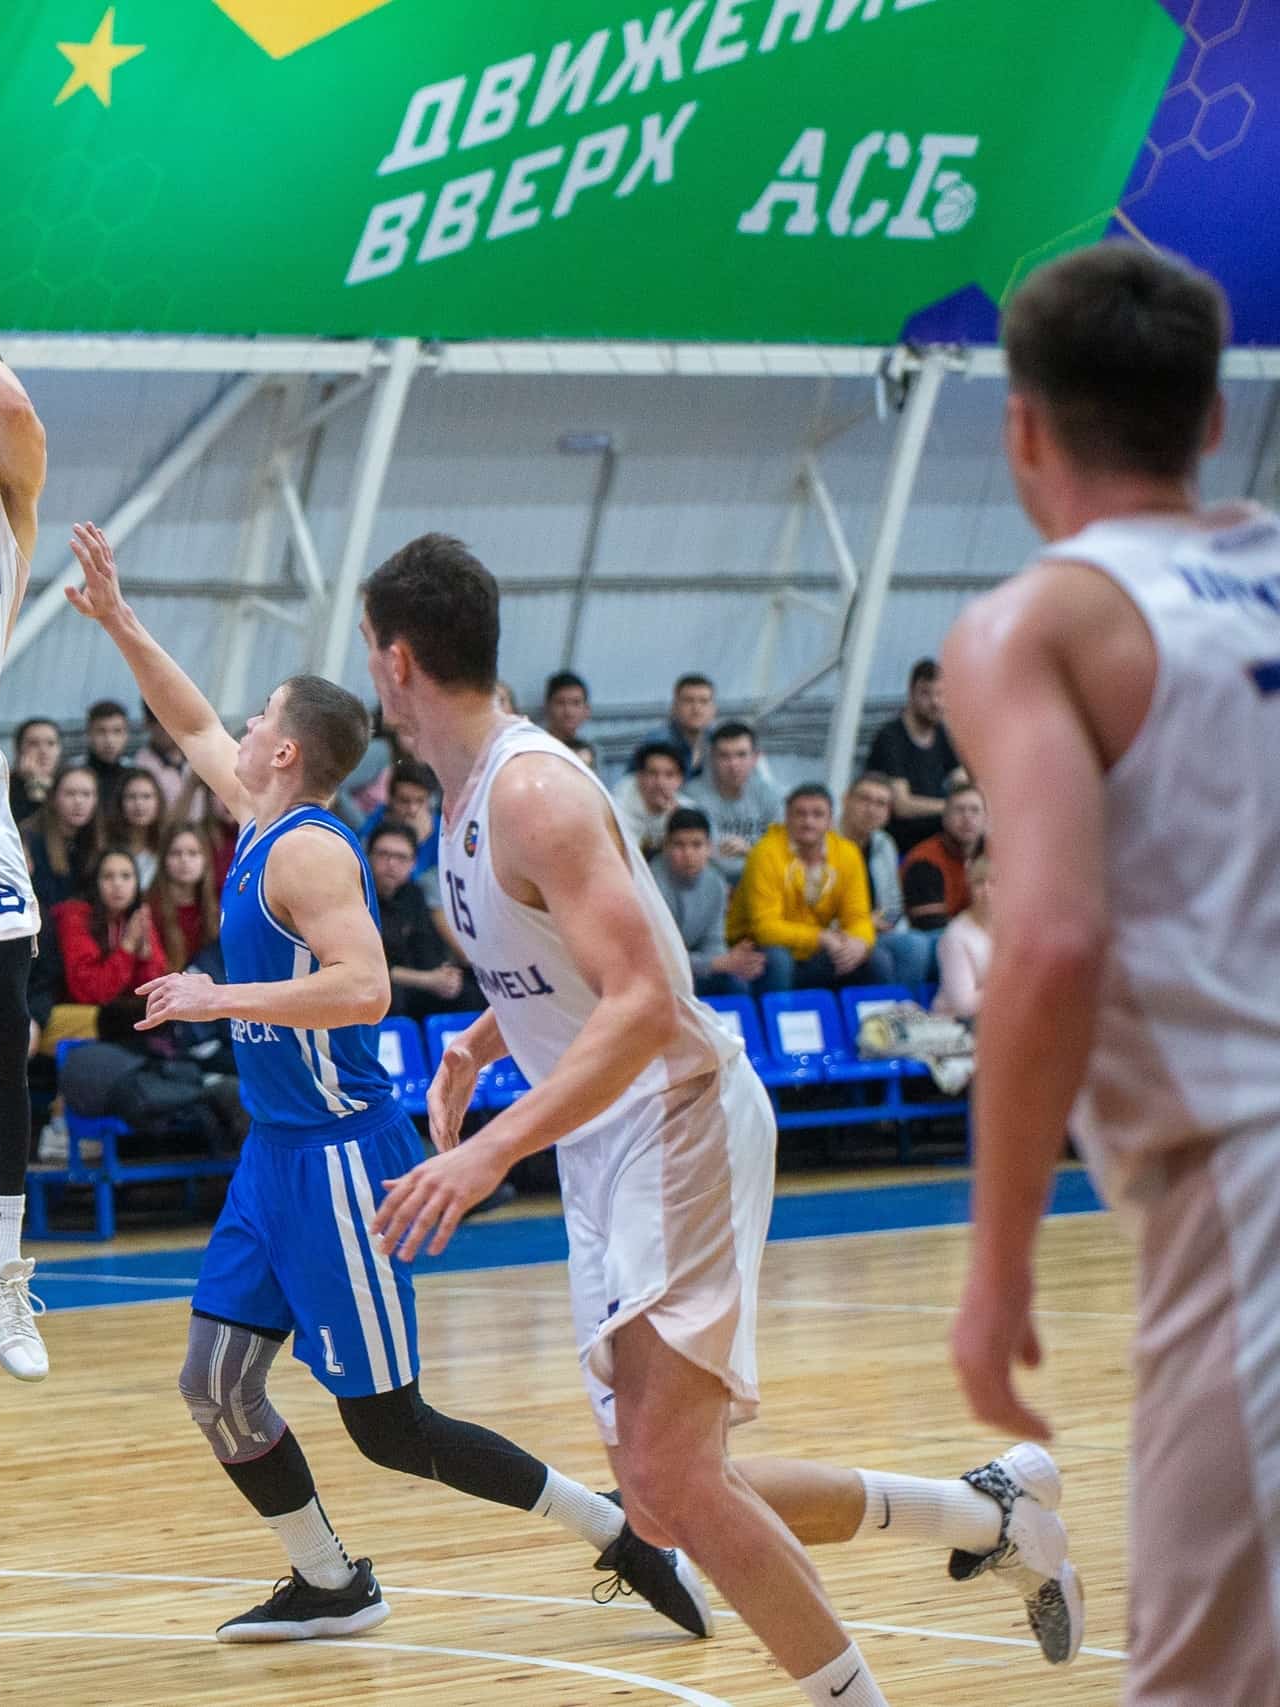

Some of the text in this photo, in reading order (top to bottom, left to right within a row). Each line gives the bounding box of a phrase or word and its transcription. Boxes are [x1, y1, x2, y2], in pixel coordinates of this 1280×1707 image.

[376, 0, 937, 176] ДВИЖЕН
[344, 100, 698, 287] ВВЕРХ
[737, 127, 979, 240] АСБ
[446, 869, 477, 940] 15
